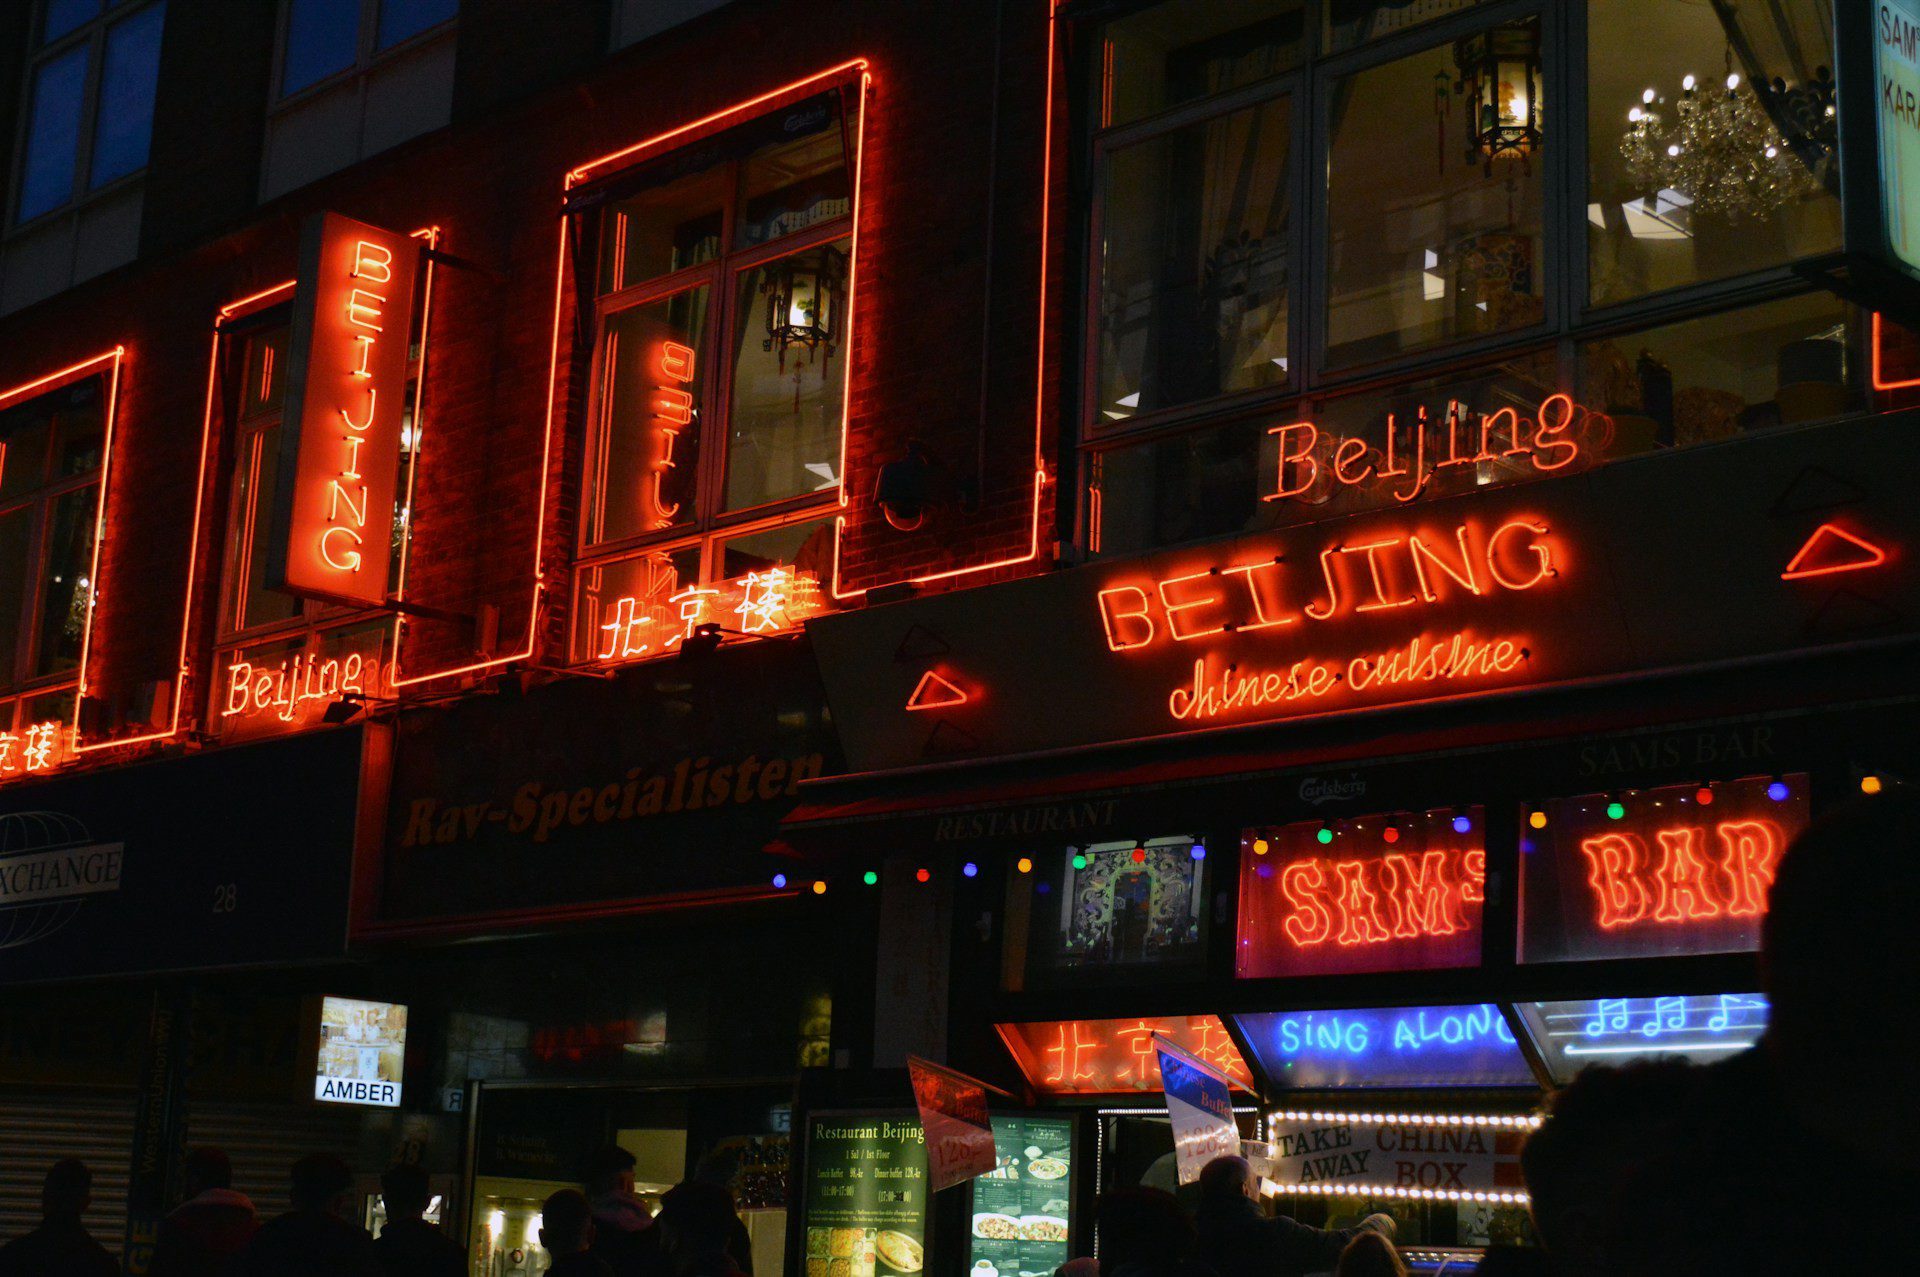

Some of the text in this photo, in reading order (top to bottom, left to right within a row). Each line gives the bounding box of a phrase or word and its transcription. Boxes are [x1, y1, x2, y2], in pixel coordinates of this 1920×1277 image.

[1883, 73, 1920, 132] KAR
[321, 239, 393, 574] BEIJING
[1262, 393, 1578, 502] Beijing
[598, 567, 789, 660] 北京楼
[1098, 521, 1556, 652] BEIJING
[221, 653, 363, 722] Beijing
[1348, 634, 1526, 692] cuisine
[1696, 725, 1775, 765] BAR
[402, 752, 825, 850] Rav-Specialisten
[1298, 773, 1368, 805] Carlsberg
[934, 800, 1119, 842] RESTAURANT
[212, 883, 238, 913] 28
[1581, 820, 1775, 928] BAR
[322, 1080, 394, 1102] AMBER
[816, 1121, 925, 1145] Restaurant Beijing
[1277, 1124, 1488, 1158] TAKE CHINA
[1299, 1149, 1469, 1189] AWAY BOX
